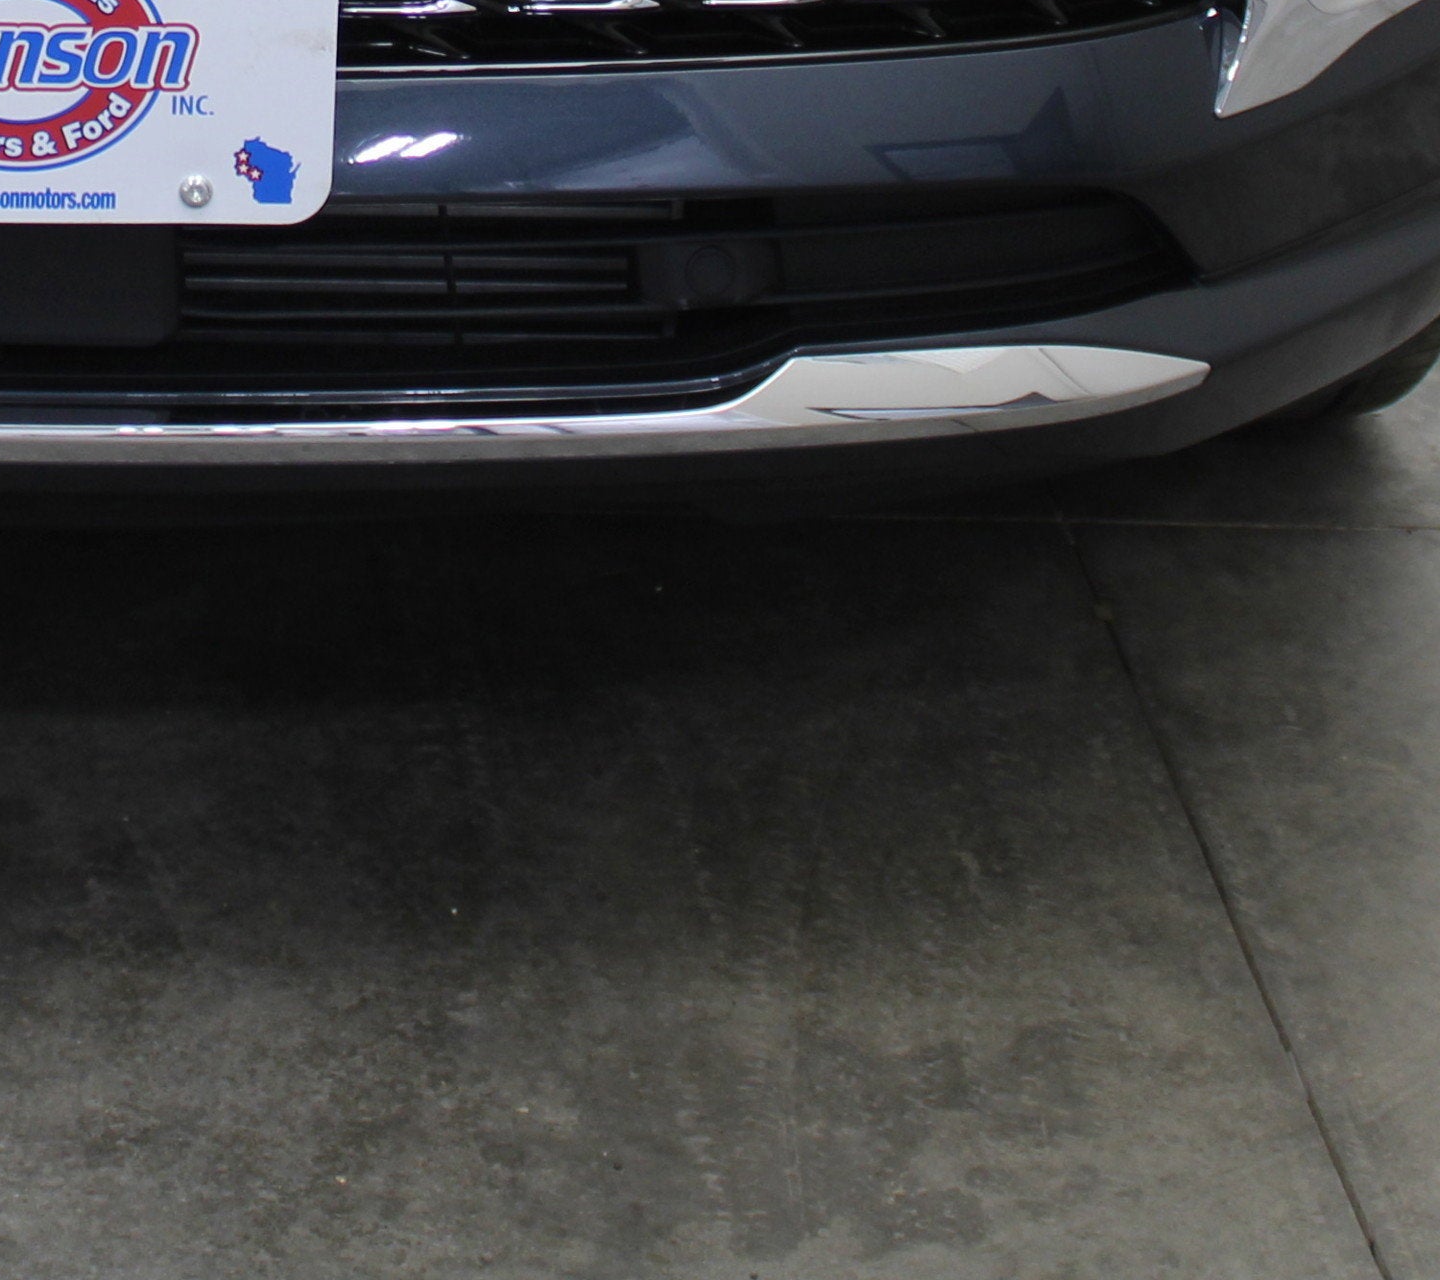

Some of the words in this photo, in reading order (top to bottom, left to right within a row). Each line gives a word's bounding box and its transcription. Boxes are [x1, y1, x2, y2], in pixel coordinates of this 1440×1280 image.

[31, 131, 58, 158] &
[61, 92, 133, 151] Ford
[172, 95, 214, 116] INC.
